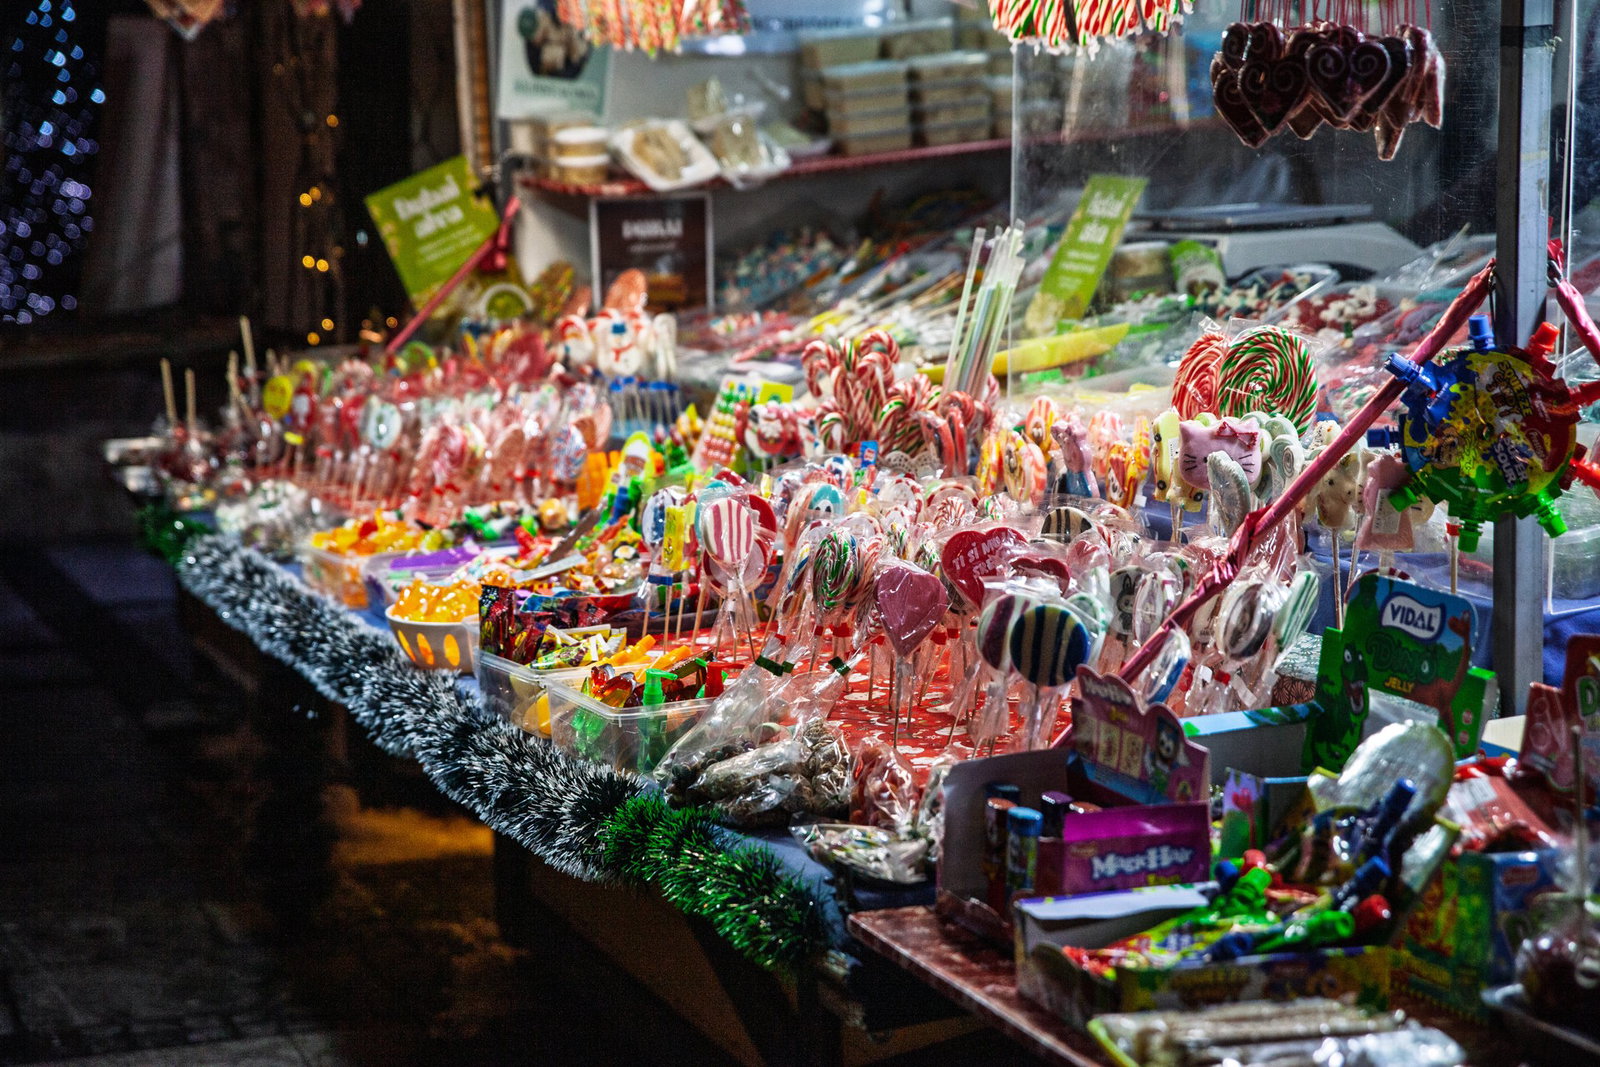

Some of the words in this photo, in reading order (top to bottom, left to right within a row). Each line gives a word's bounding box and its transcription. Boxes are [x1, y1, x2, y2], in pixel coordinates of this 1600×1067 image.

[1498, 360, 1533, 418] SQUEEZE
[1494, 442, 1517, 483] SOUR
[952, 555, 966, 570] TI
[1391, 603, 1435, 632] VIDAL
[1384, 676, 1415, 693] JELLY
